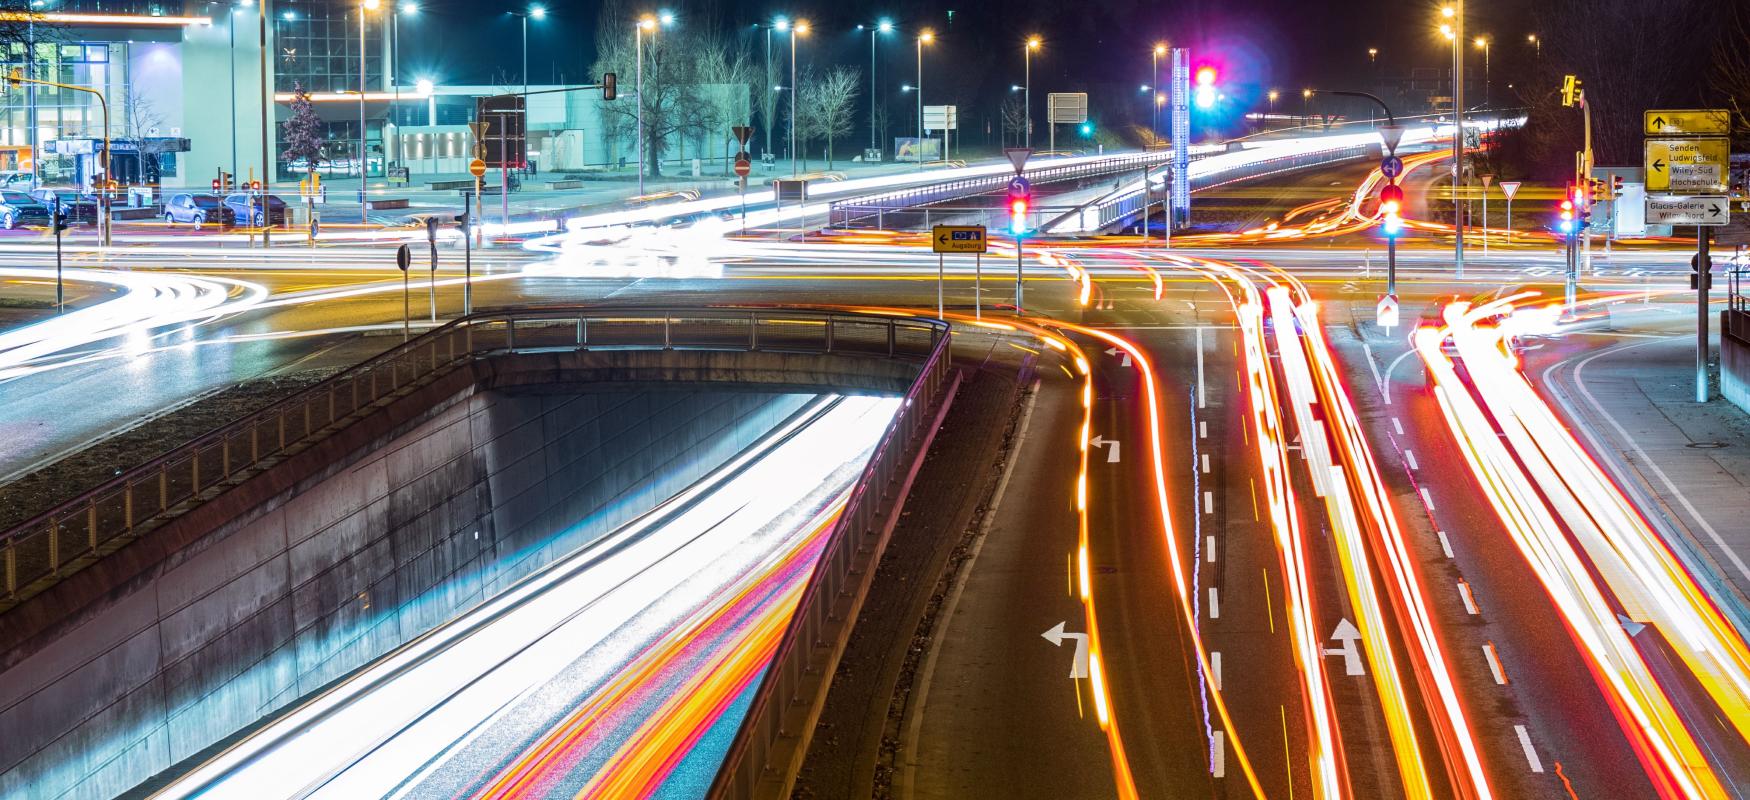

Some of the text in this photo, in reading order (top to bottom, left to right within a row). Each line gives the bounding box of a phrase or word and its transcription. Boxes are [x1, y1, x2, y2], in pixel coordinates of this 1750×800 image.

[1669, 154, 1717, 163] Ludwigsfeld
[1659, 212, 1704, 220] WileyNord
[951, 242, 981, 250] Augsburg
